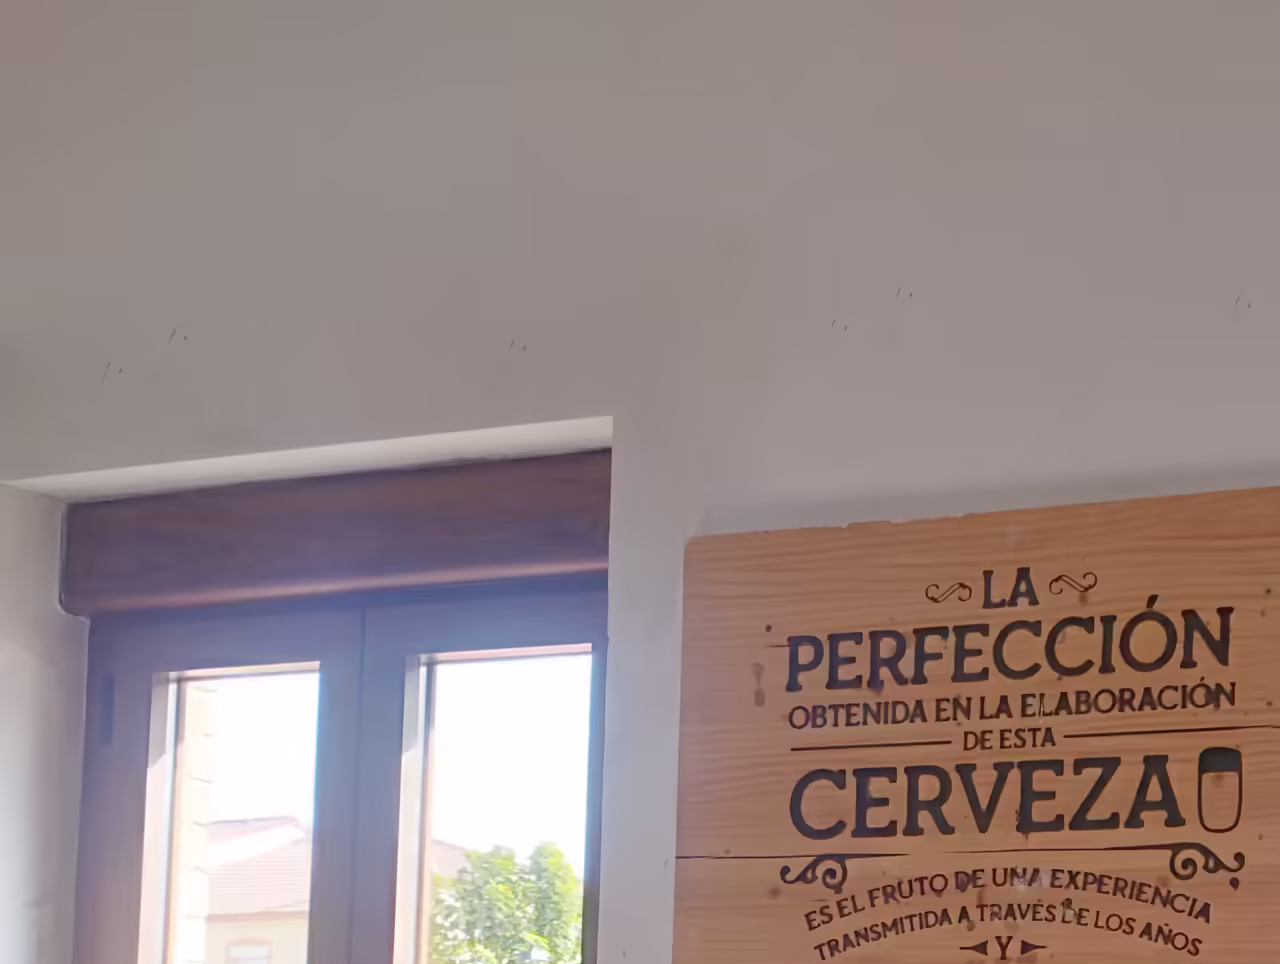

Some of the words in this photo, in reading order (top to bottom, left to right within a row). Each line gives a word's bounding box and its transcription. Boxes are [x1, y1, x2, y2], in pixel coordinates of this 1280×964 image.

[982, 567, 1039, 609] LA
[785, 594, 1234, 692] PERFECCIÓN
[788, 699, 927, 729] OBTENIDA
[934, 696, 972, 722] EN
[978, 695, 1013, 719] LA
[1020, 677, 1236, 718] ELABORACIÓN
[963, 730, 993, 751] DE
[1000, 727, 1056, 749] ESTA
[789, 755, 1186, 840] CERVEZA
[804, 905, 833, 931] ES
[836, 895, 865, 918] EL
[867, 873, 948, 907] FRUTO
[954, 869, 985, 890] DE
[992, 867, 1042, 887] UNA
[1049, 868, 1211, 924] EXPERIENCIA
[814, 908, 952, 960] TRANSMITIDA
[958, 906, 971, 923] A
[976, 899, 1056, 922] TRAVÉS
[1061, 902, 1090, 926] DE
[1094, 910, 1136, 935] LOS
[1139, 922, 1202, 956] AÑOS
[995, 936, 1013, 960] Y
